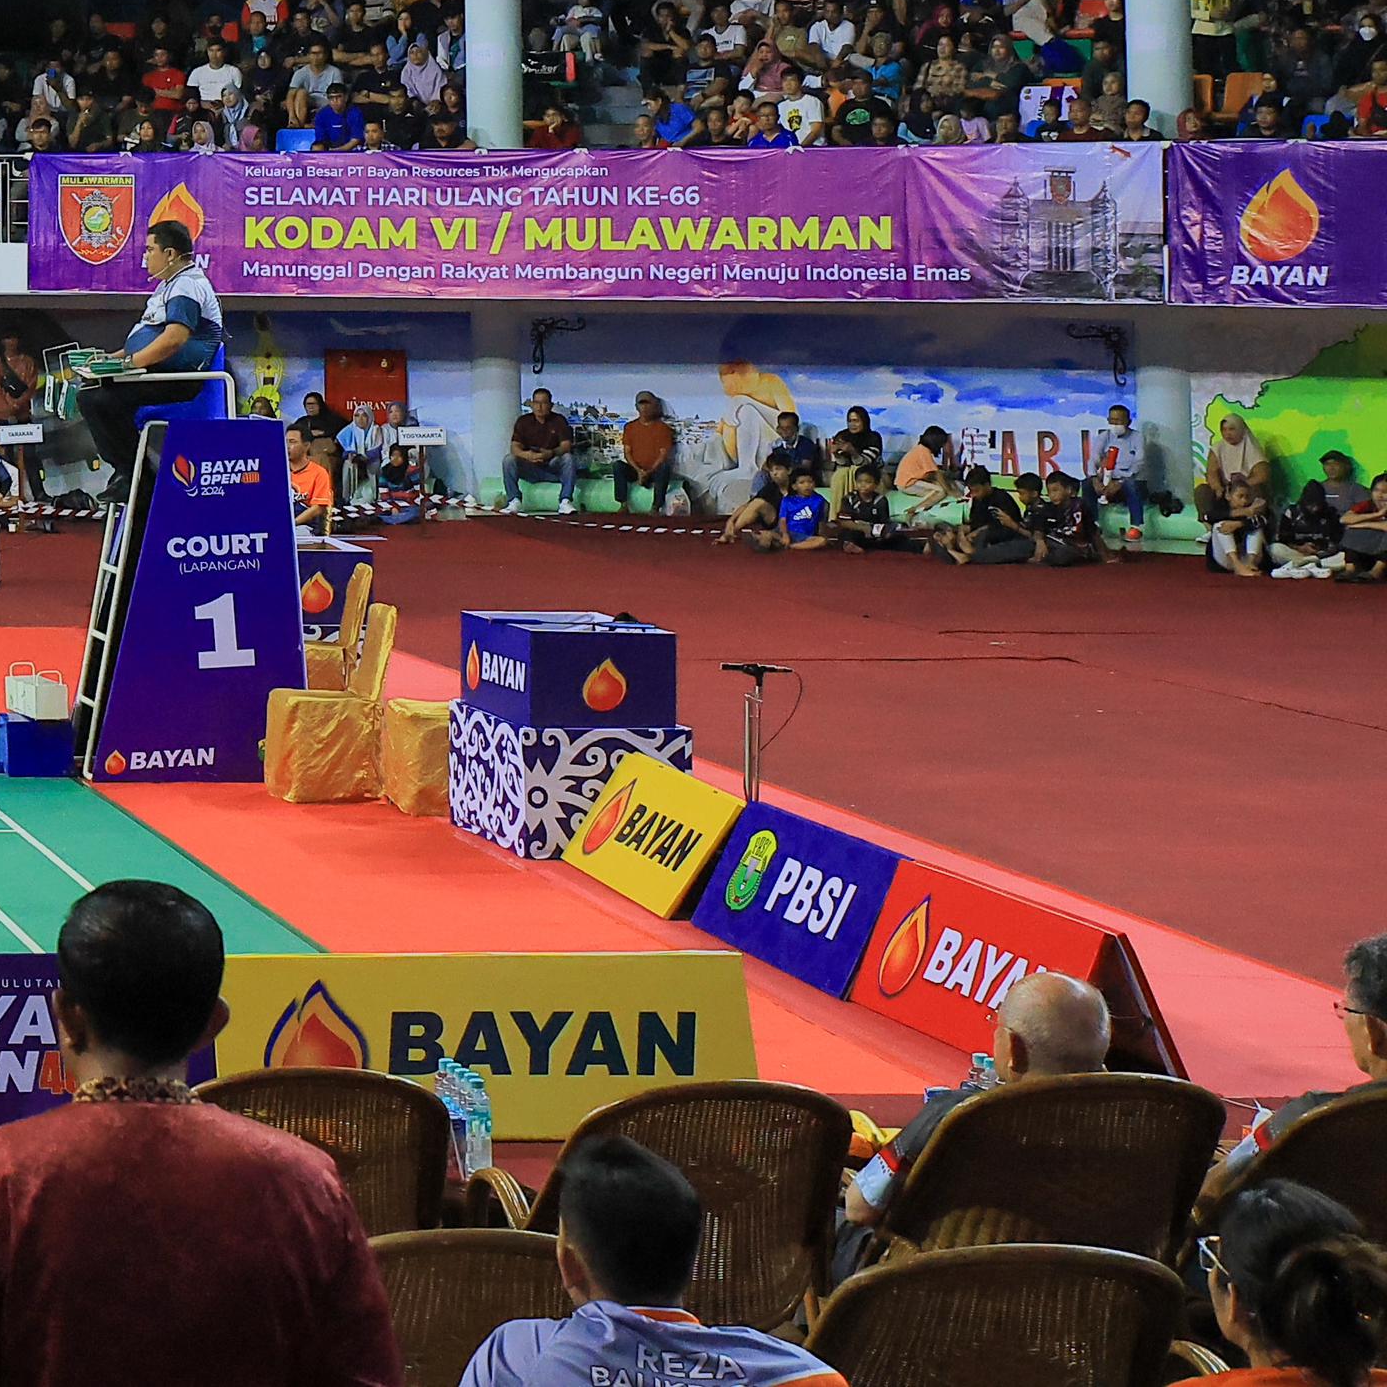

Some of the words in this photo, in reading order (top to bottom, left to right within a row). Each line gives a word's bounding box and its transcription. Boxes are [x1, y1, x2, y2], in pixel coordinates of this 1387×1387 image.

[62, 176, 132, 185] MULAWARMAN
[245, 165, 303, 179] Keluarga
[307, 165, 343, 177] Besar
[348, 166, 364, 177] PT
[368, 166, 407, 180] Bayan
[412, 166, 480, 178] Resources
[482, 165, 509, 178] Tbk
[512, 165, 608, 180] Mengucapkan
[245, 186, 360, 206] SELAMAT
[368, 186, 428, 206] HARI
[435, 186, 523, 207] ULANG
[531, 186, 618, 206] TAHUN
[627, 186, 699, 206] KE-66
[245, 217, 416, 250] KODAM
[430, 218, 477, 250] VI
[525, 216, 893, 250] MULAWARMAN
[244, 262, 351, 282] Manunggal
[359, 263, 435, 283] Dengan
[442, 263, 509, 283] Rakyat
[515, 263, 642, 284] Membangun
[650, 263, 716, 284] Negeri
[724, 264, 799, 284] Menuju
[807, 263, 907, 282] Indonesia
[914, 264, 971, 282] Emas
[1230, 264, 1327, 287] BAYAN
[201, 459, 259, 474] BAYAN
[201, 487, 225, 496] 2024
[167, 533, 268, 558] COURT
[179, 558, 260, 575] (LAPANGAN)
[194, 592, 256, 670] 1
[481, 649, 526, 694] BAYAN
[130, 747, 215, 771] BAYAN
[614, 803, 703, 873] BAYAN
[764, 857, 858, 941] PBSI
[924, 928, 1047, 1010] BAYA
[390, 1010, 697, 1076] BAYAN
[637, 1343, 745, 1379] REZA
